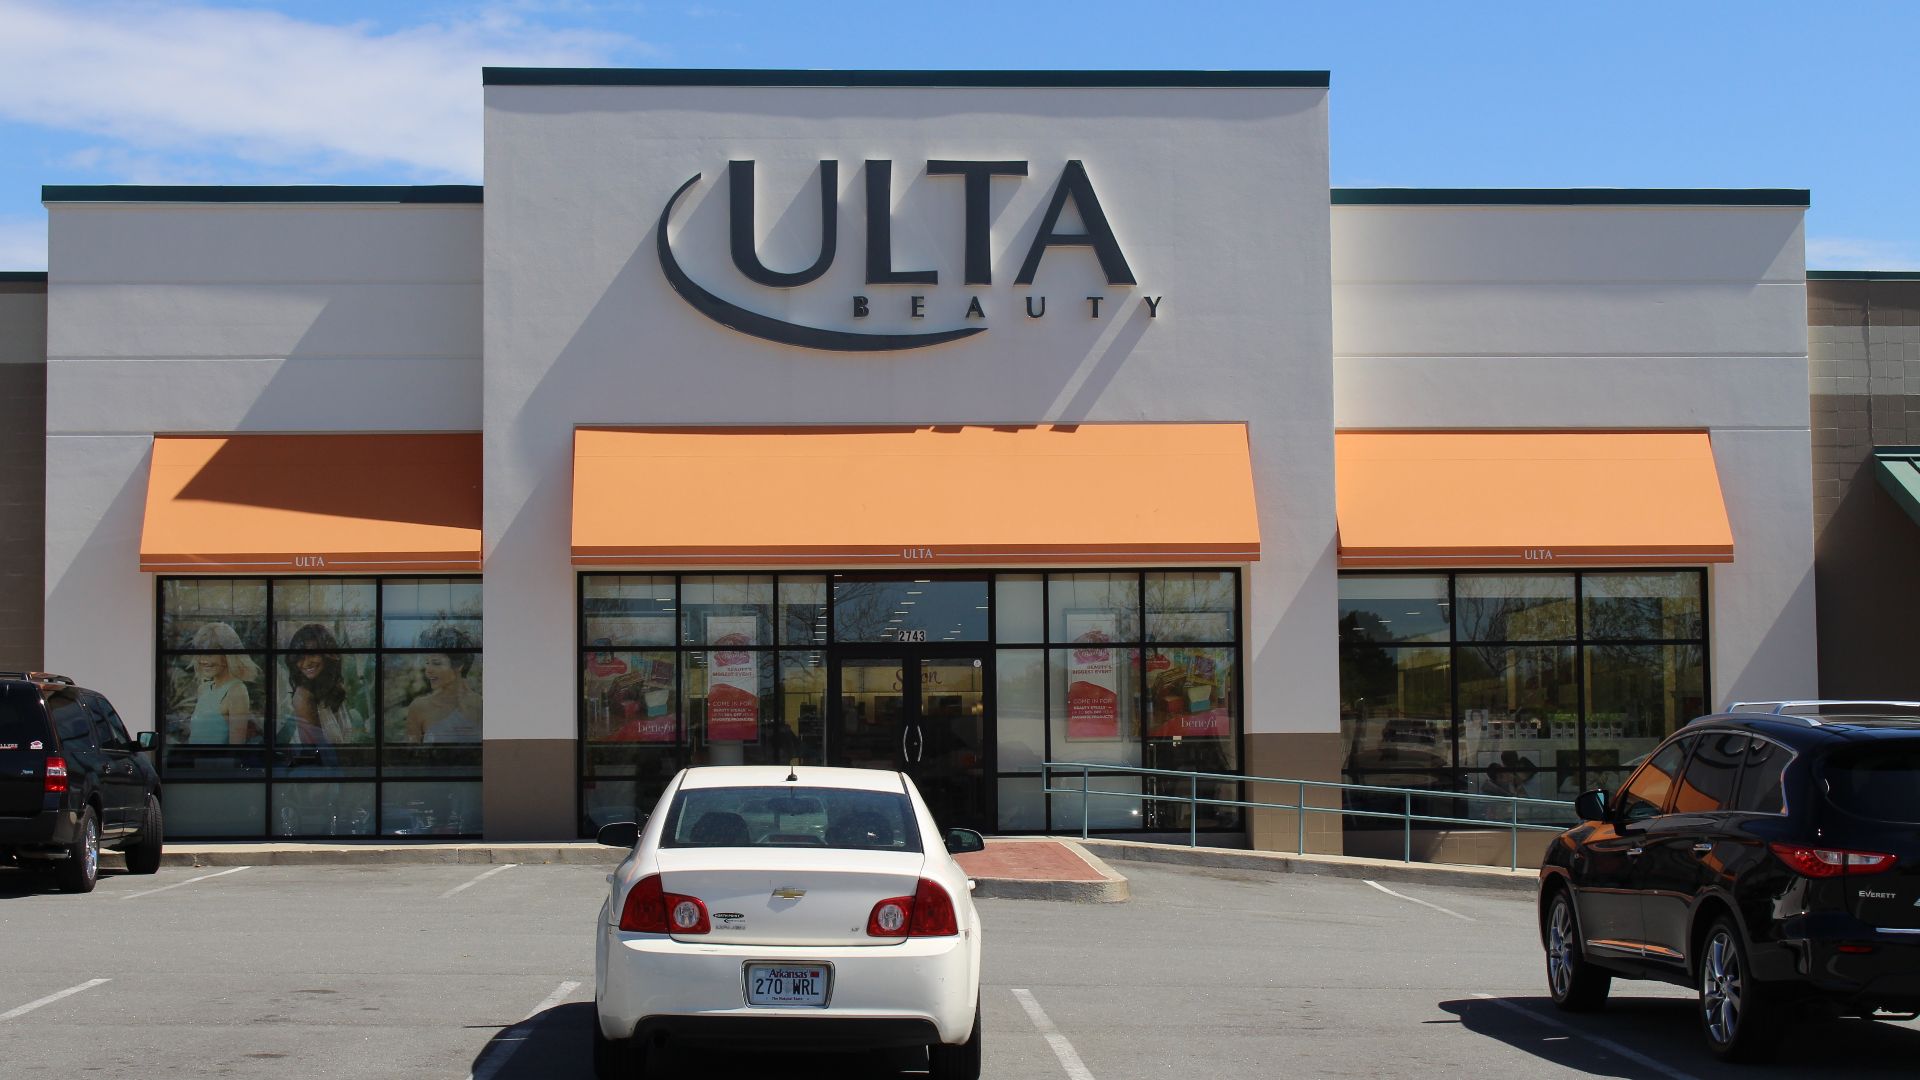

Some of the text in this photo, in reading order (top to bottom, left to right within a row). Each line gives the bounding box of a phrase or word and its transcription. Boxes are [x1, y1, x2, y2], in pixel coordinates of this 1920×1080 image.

[729, 160, 1137, 288] ULTA
[853, 296, 1163, 319] BEAUTY
[904, 548, 933, 559] ULTA
[1524, 549, 1553, 560] ULTA
[295, 556, 325, 567] ULTA
[899, 630, 925, 641] 2743
[1858, 889, 1896, 899] EVERETT
[769, 968, 808, 979] Arkansas
[755, 979, 819, 995] 270 WRL
